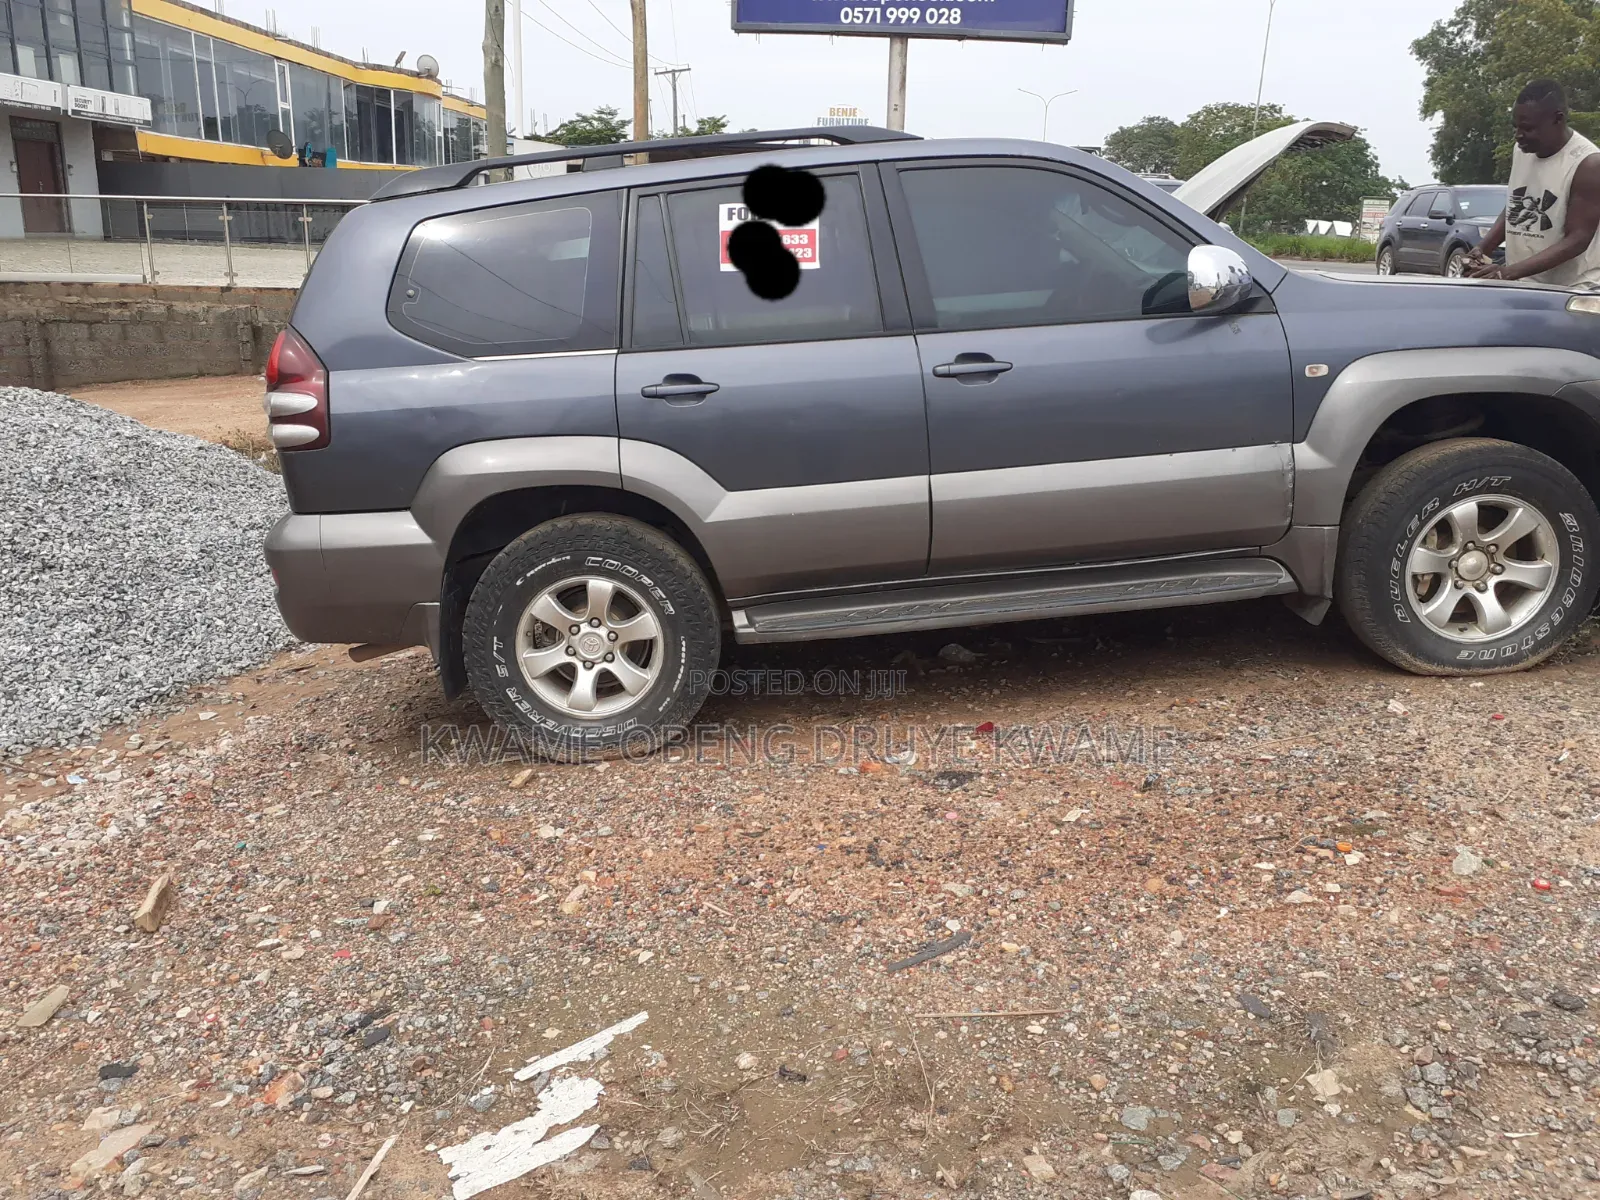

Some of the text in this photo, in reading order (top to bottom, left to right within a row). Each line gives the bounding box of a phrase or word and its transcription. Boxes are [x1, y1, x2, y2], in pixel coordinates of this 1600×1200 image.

[840, 8, 961, 24] 0571 999 028
[816, 117, 870, 126] FURNITURE
[829, 107, 858, 117] BENJE
[1389, 475, 1512, 623] DUELER H/T
[584, 556, 676, 616] COOPER
[1456, 511, 1585, 661] BRIDGESTONE
[506, 687, 639, 739] DISCOVERER
